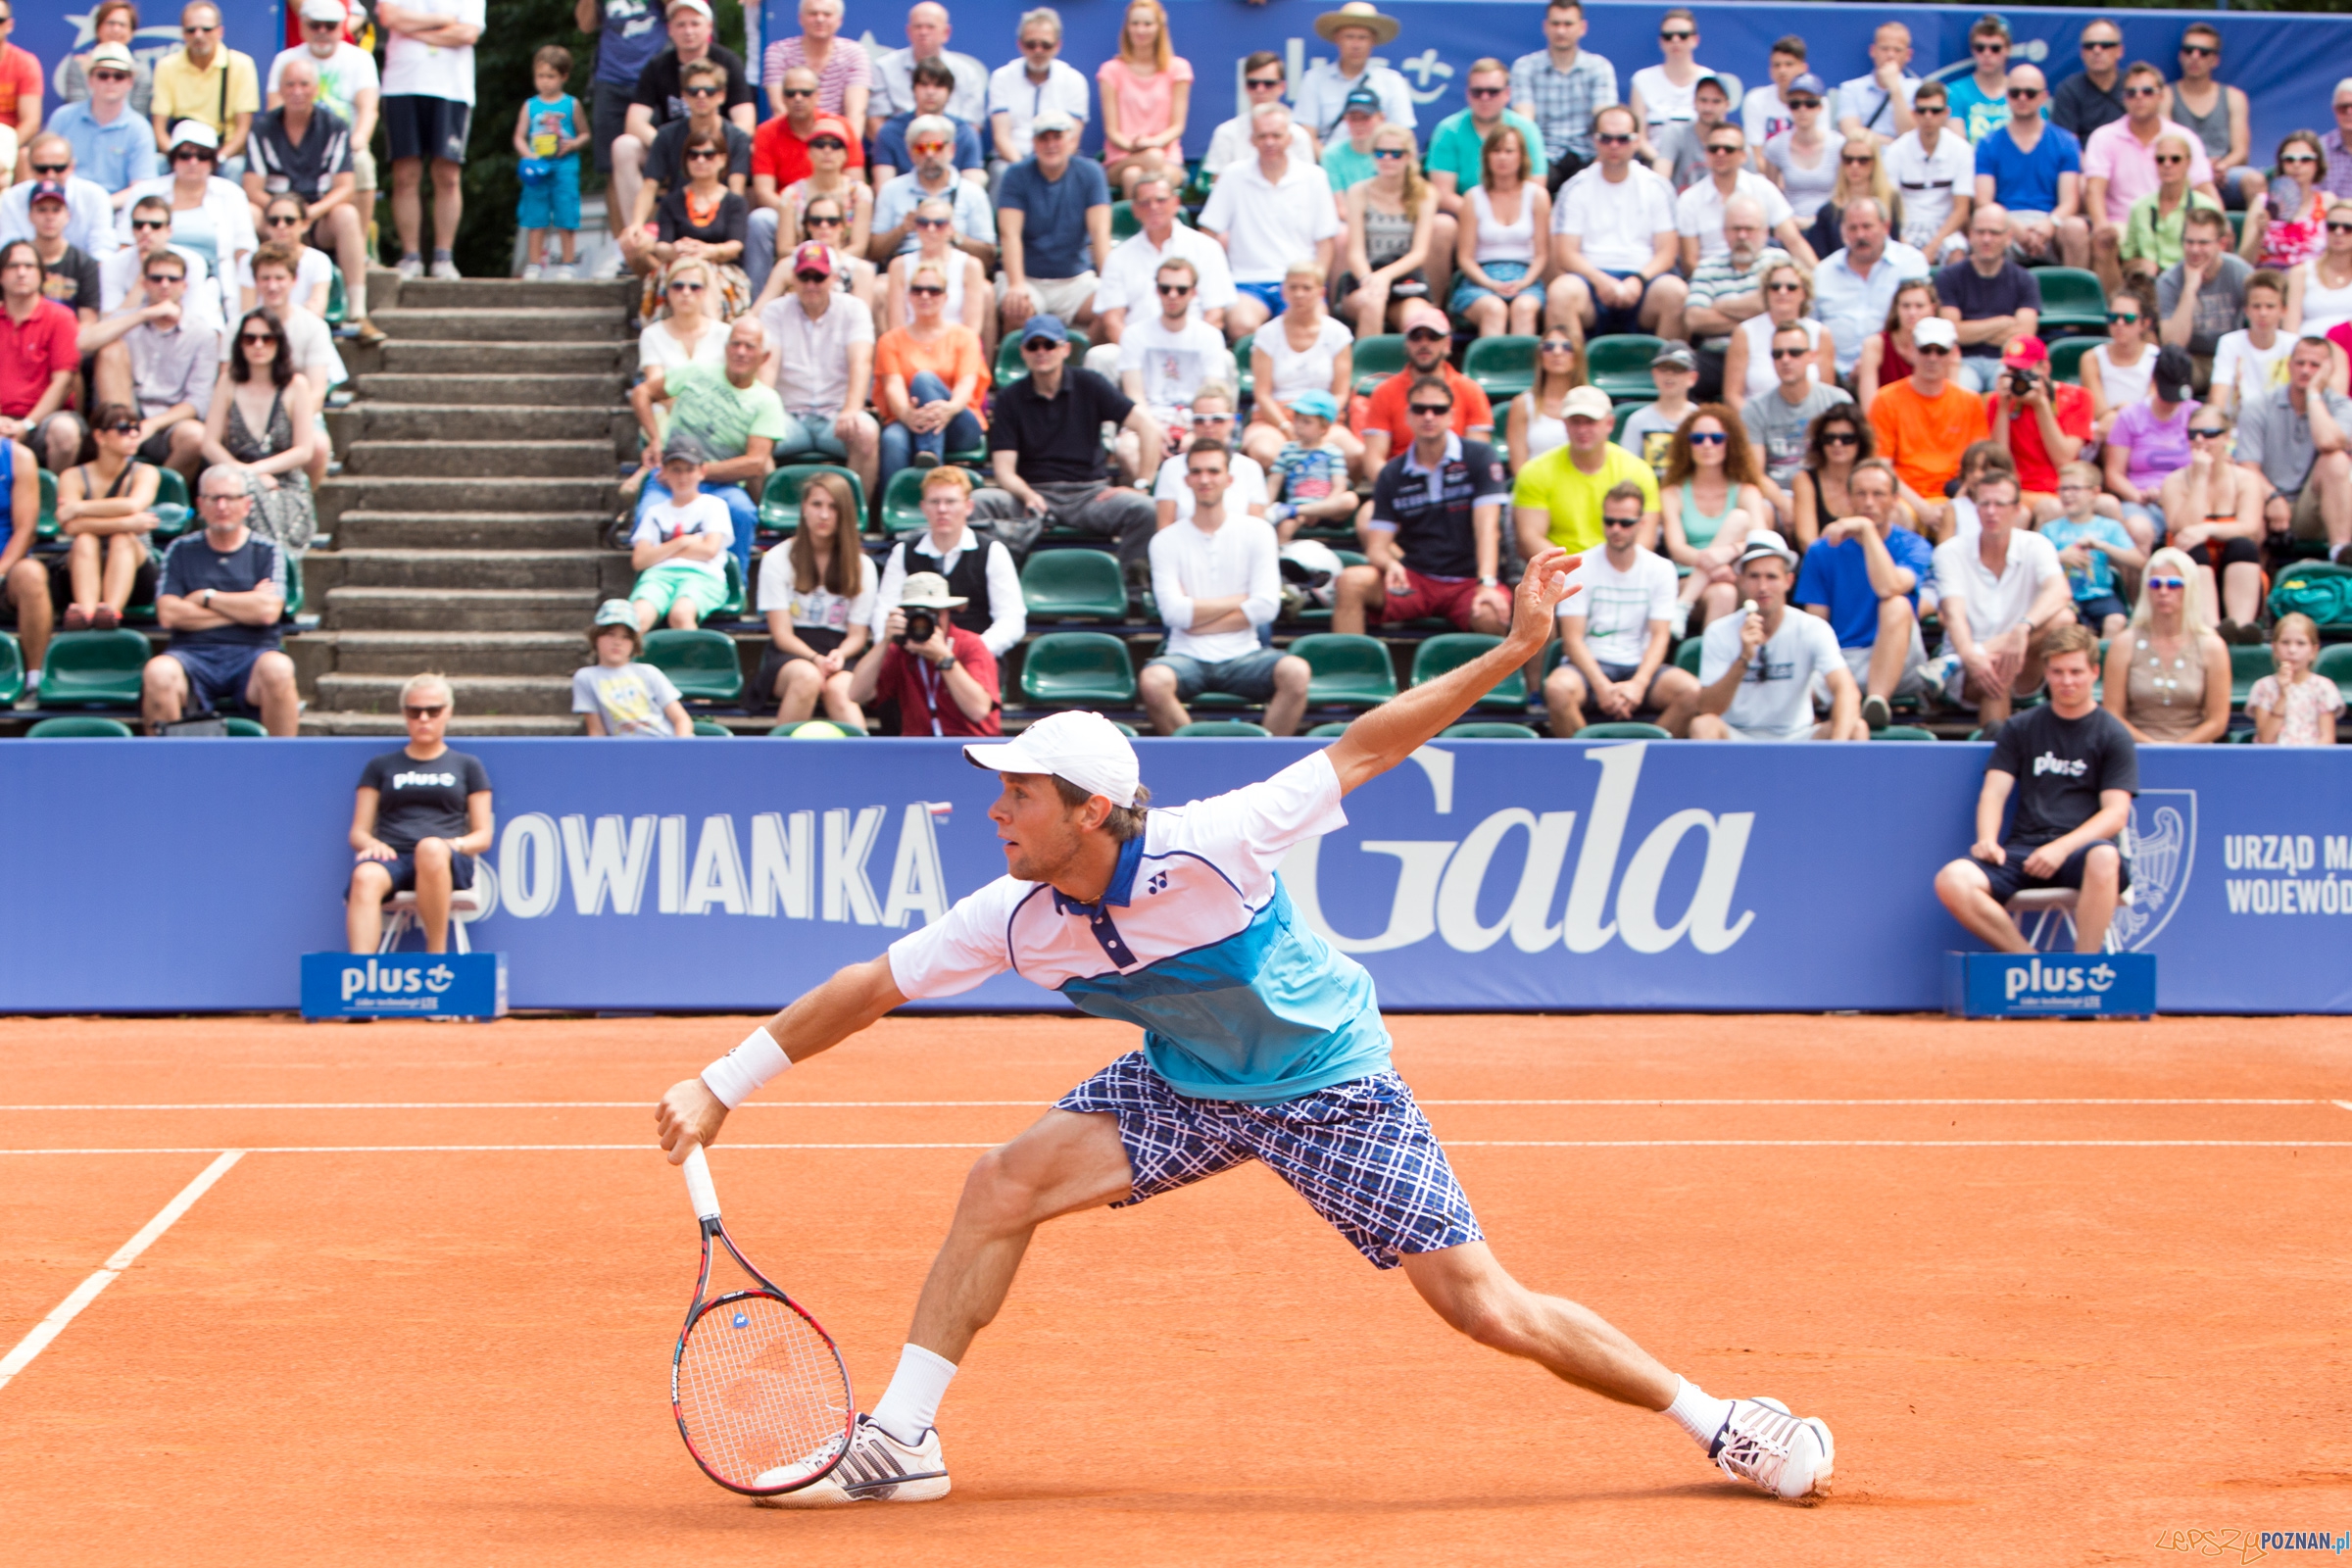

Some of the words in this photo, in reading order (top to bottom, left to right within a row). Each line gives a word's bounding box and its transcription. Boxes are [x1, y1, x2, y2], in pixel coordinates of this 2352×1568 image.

[393, 771, 440, 790] plus
[2034, 751, 2070, 776] plus
[1284, 740, 1756, 954] Gala
[2224, 834, 2315, 876] URZĄD
[2324, 834, 2352, 870] M
[2226, 871, 2352, 914] WOJEWÓD
[341, 958, 421, 1002] plus
[2005, 957, 2084, 1001] plus
